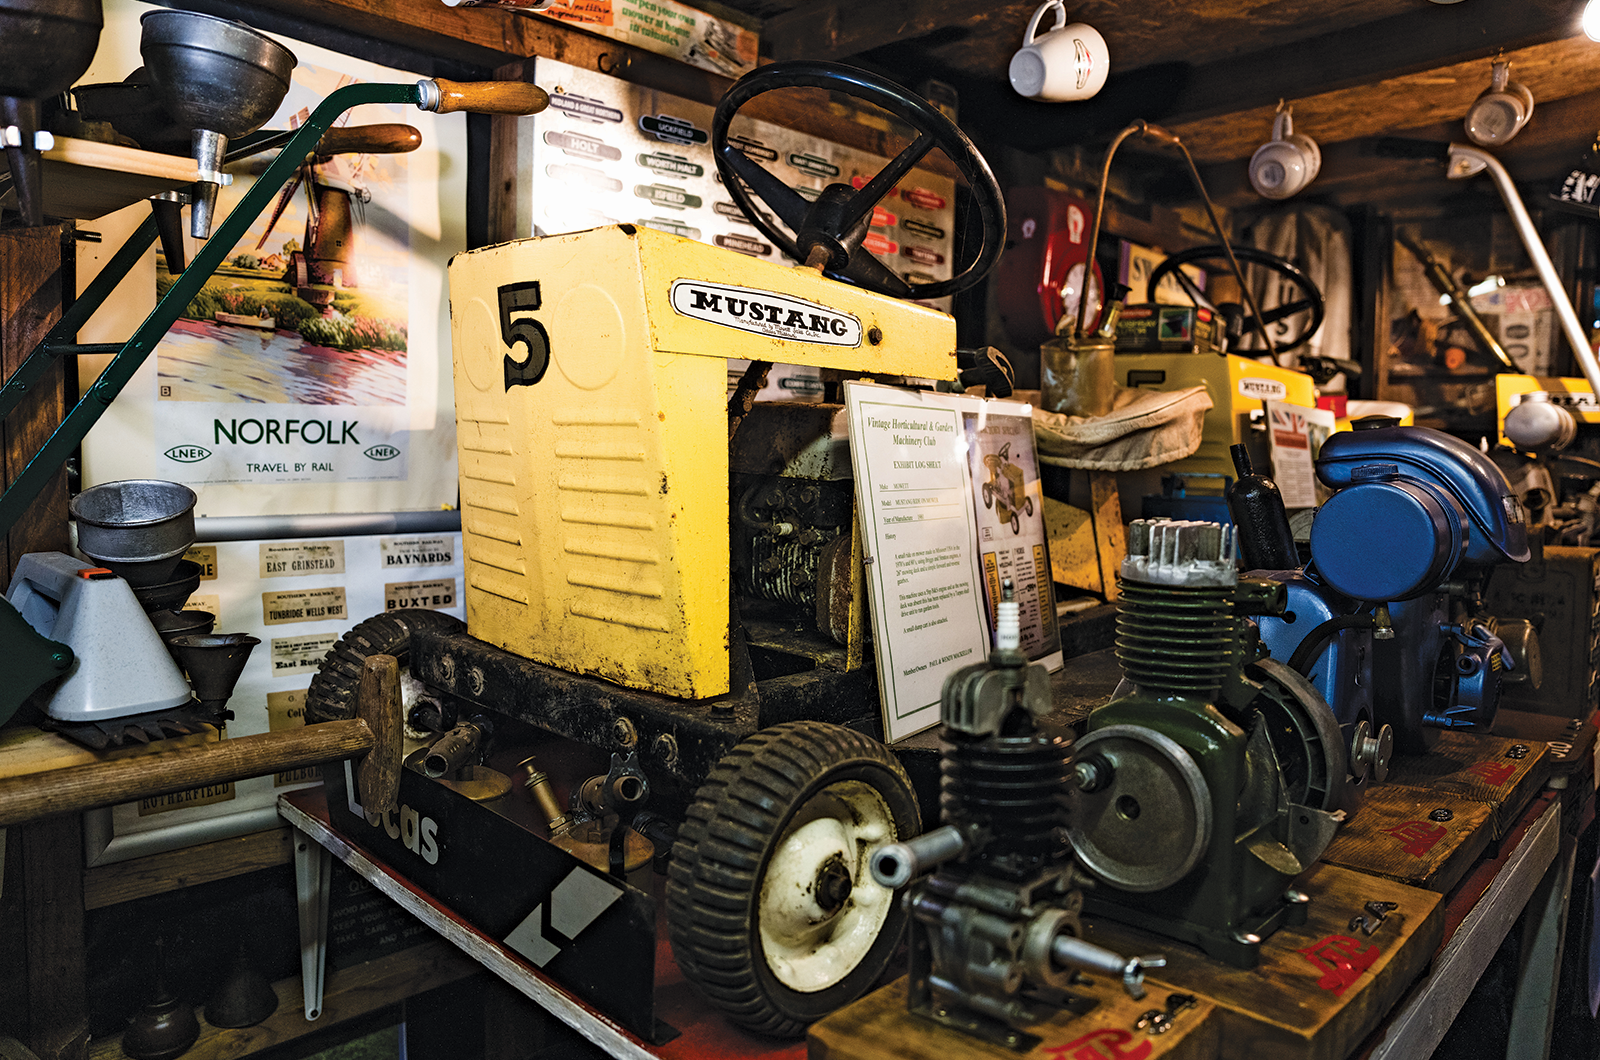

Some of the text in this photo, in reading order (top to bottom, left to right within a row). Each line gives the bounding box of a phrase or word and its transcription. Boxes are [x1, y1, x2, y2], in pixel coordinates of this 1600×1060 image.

[658, 122, 694, 138] UCKFIELD
[570, 138, 600, 153] HOLT
[724, 238, 764, 252] MINEHEAD
[690, 290, 848, 336] MUSTANG
[498, 280, 550, 394] 5
[162, 386, 170, 396] B
[214, 418, 360, 444] NORFOLK
[867, 418, 954, 432] Vintage Horticultural & Garden
[893, 435, 936, 448] Machinery Club
[172, 449, 204, 458] LNER
[370, 448, 394, 458] LNER
[246, 462, 334, 472] TRAVEL BY RAIL
[266, 558, 335, 572] EAST GRINSTEAD
[387, 552, 452, 565] BAYNARDS
[388, 595, 452, 609] BUXTED
[270, 605, 343, 620] TUNBRIDGE WELLS WEST
[276, 661, 296, 669] East
[142, 784, 230, 809] ROTHERFIELD
